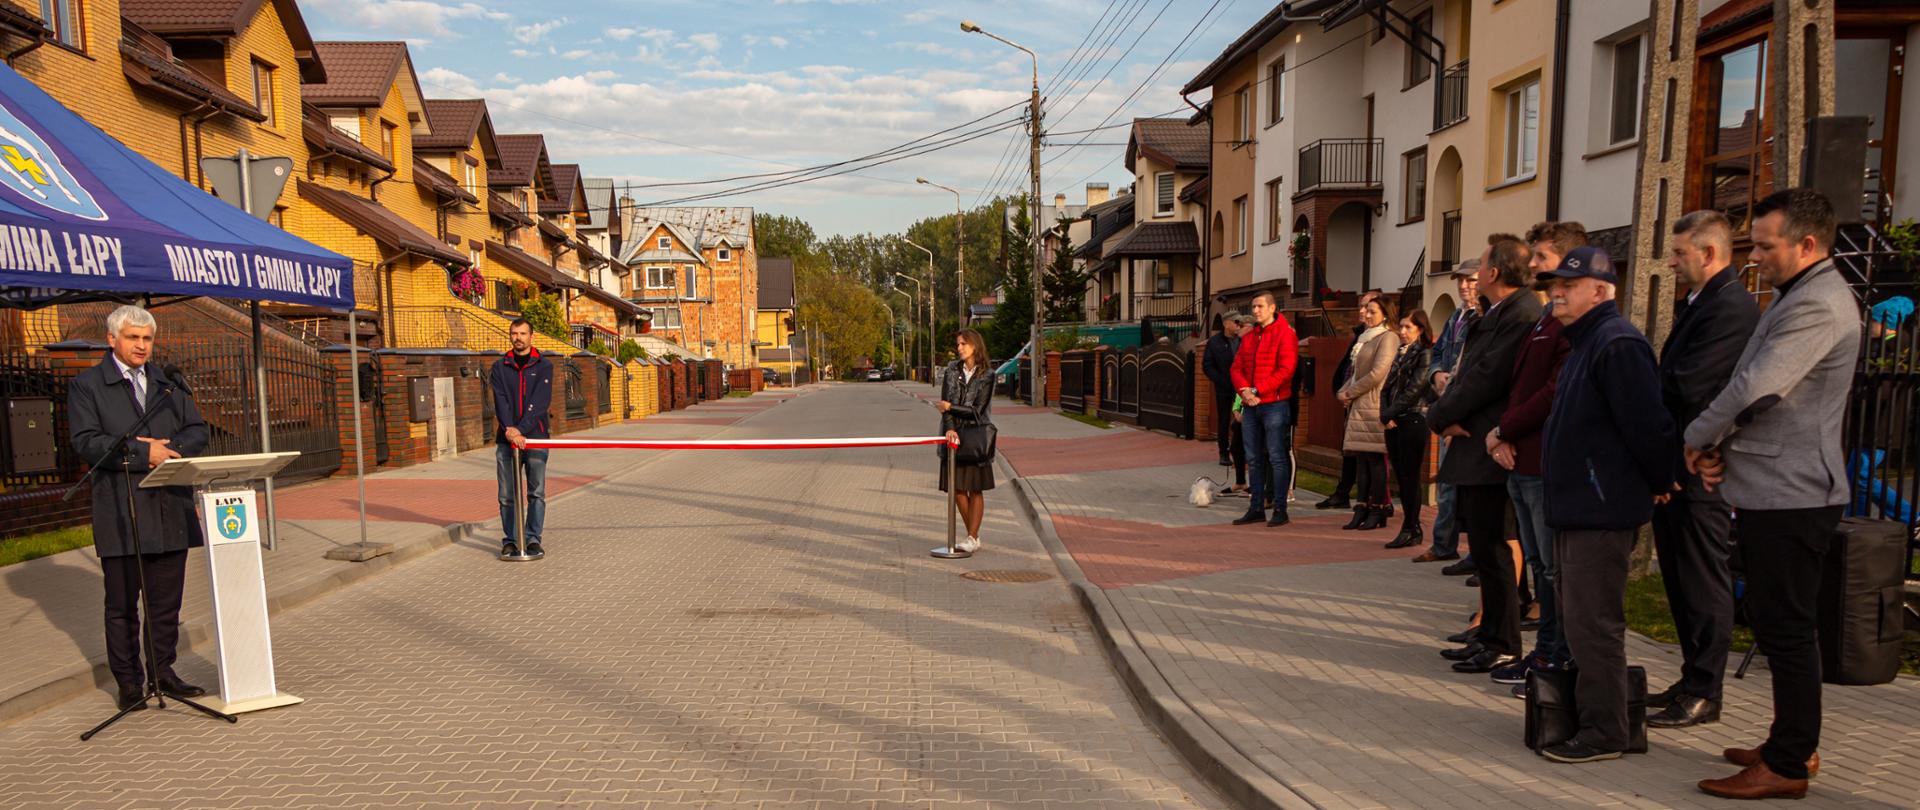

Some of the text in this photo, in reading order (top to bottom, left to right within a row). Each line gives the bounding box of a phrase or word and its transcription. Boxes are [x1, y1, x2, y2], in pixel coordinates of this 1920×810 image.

[62, 231, 126, 277] ŁAPY
[164, 244, 342, 299] MIASTO I GMINA ŁAPY
